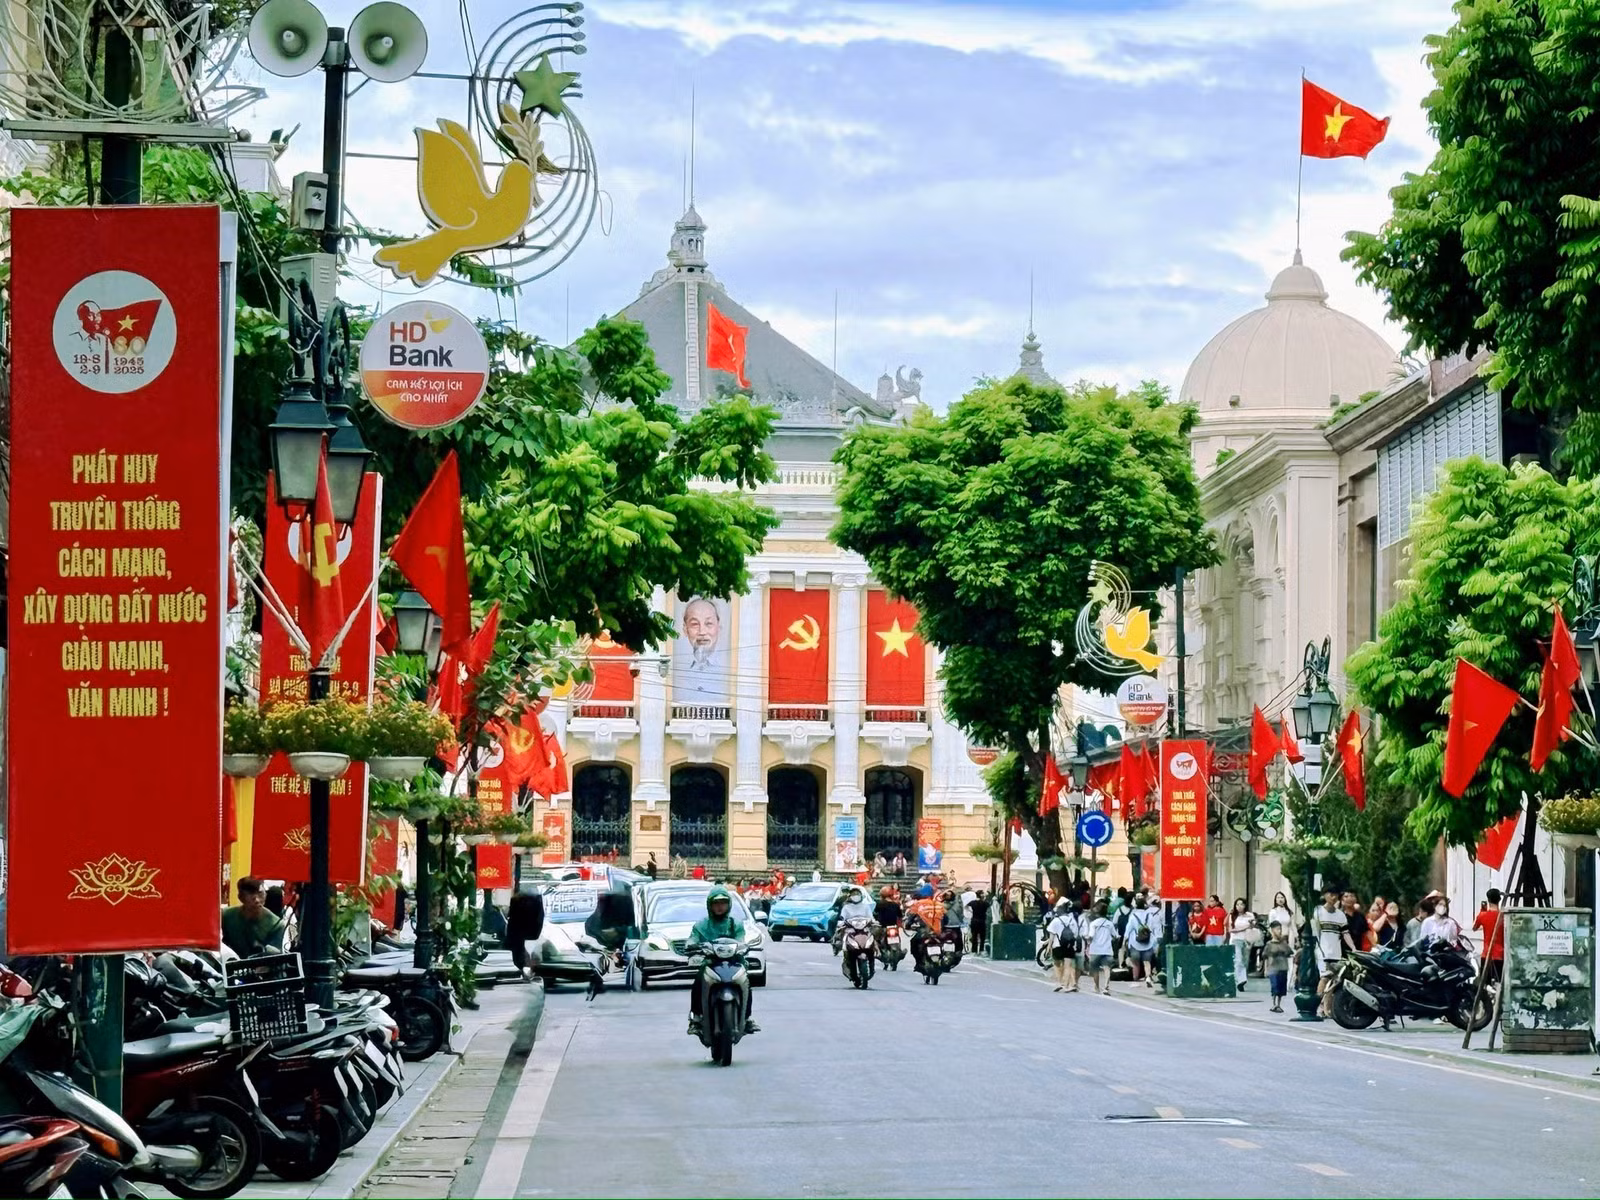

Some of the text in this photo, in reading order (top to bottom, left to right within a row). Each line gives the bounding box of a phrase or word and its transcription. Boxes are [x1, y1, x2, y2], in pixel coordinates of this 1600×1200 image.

[389, 321, 427, 343] HD
[113, 356, 144, 366] 1945
[389, 344, 454, 368] Bank
[113, 366, 145, 375] 2025
[386, 380, 408, 389] CAM
[400, 393, 421, 402] CAO
[72, 448, 159, 484] PHÁT HUY
[49, 495, 181, 531] TRUYỀN THỐNG
[58, 542, 172, 583] CÁCH MẠNG,
[23, 587, 207, 630] XÂY DỰNG ĐẤT NƯỚC
[61, 635, 169, 676] GIÀU MẠNH,
[68, 681, 169, 718] VĂN MINH !
[1128, 683, 1143, 693] HD
[1128, 692, 1154, 701] Bank
